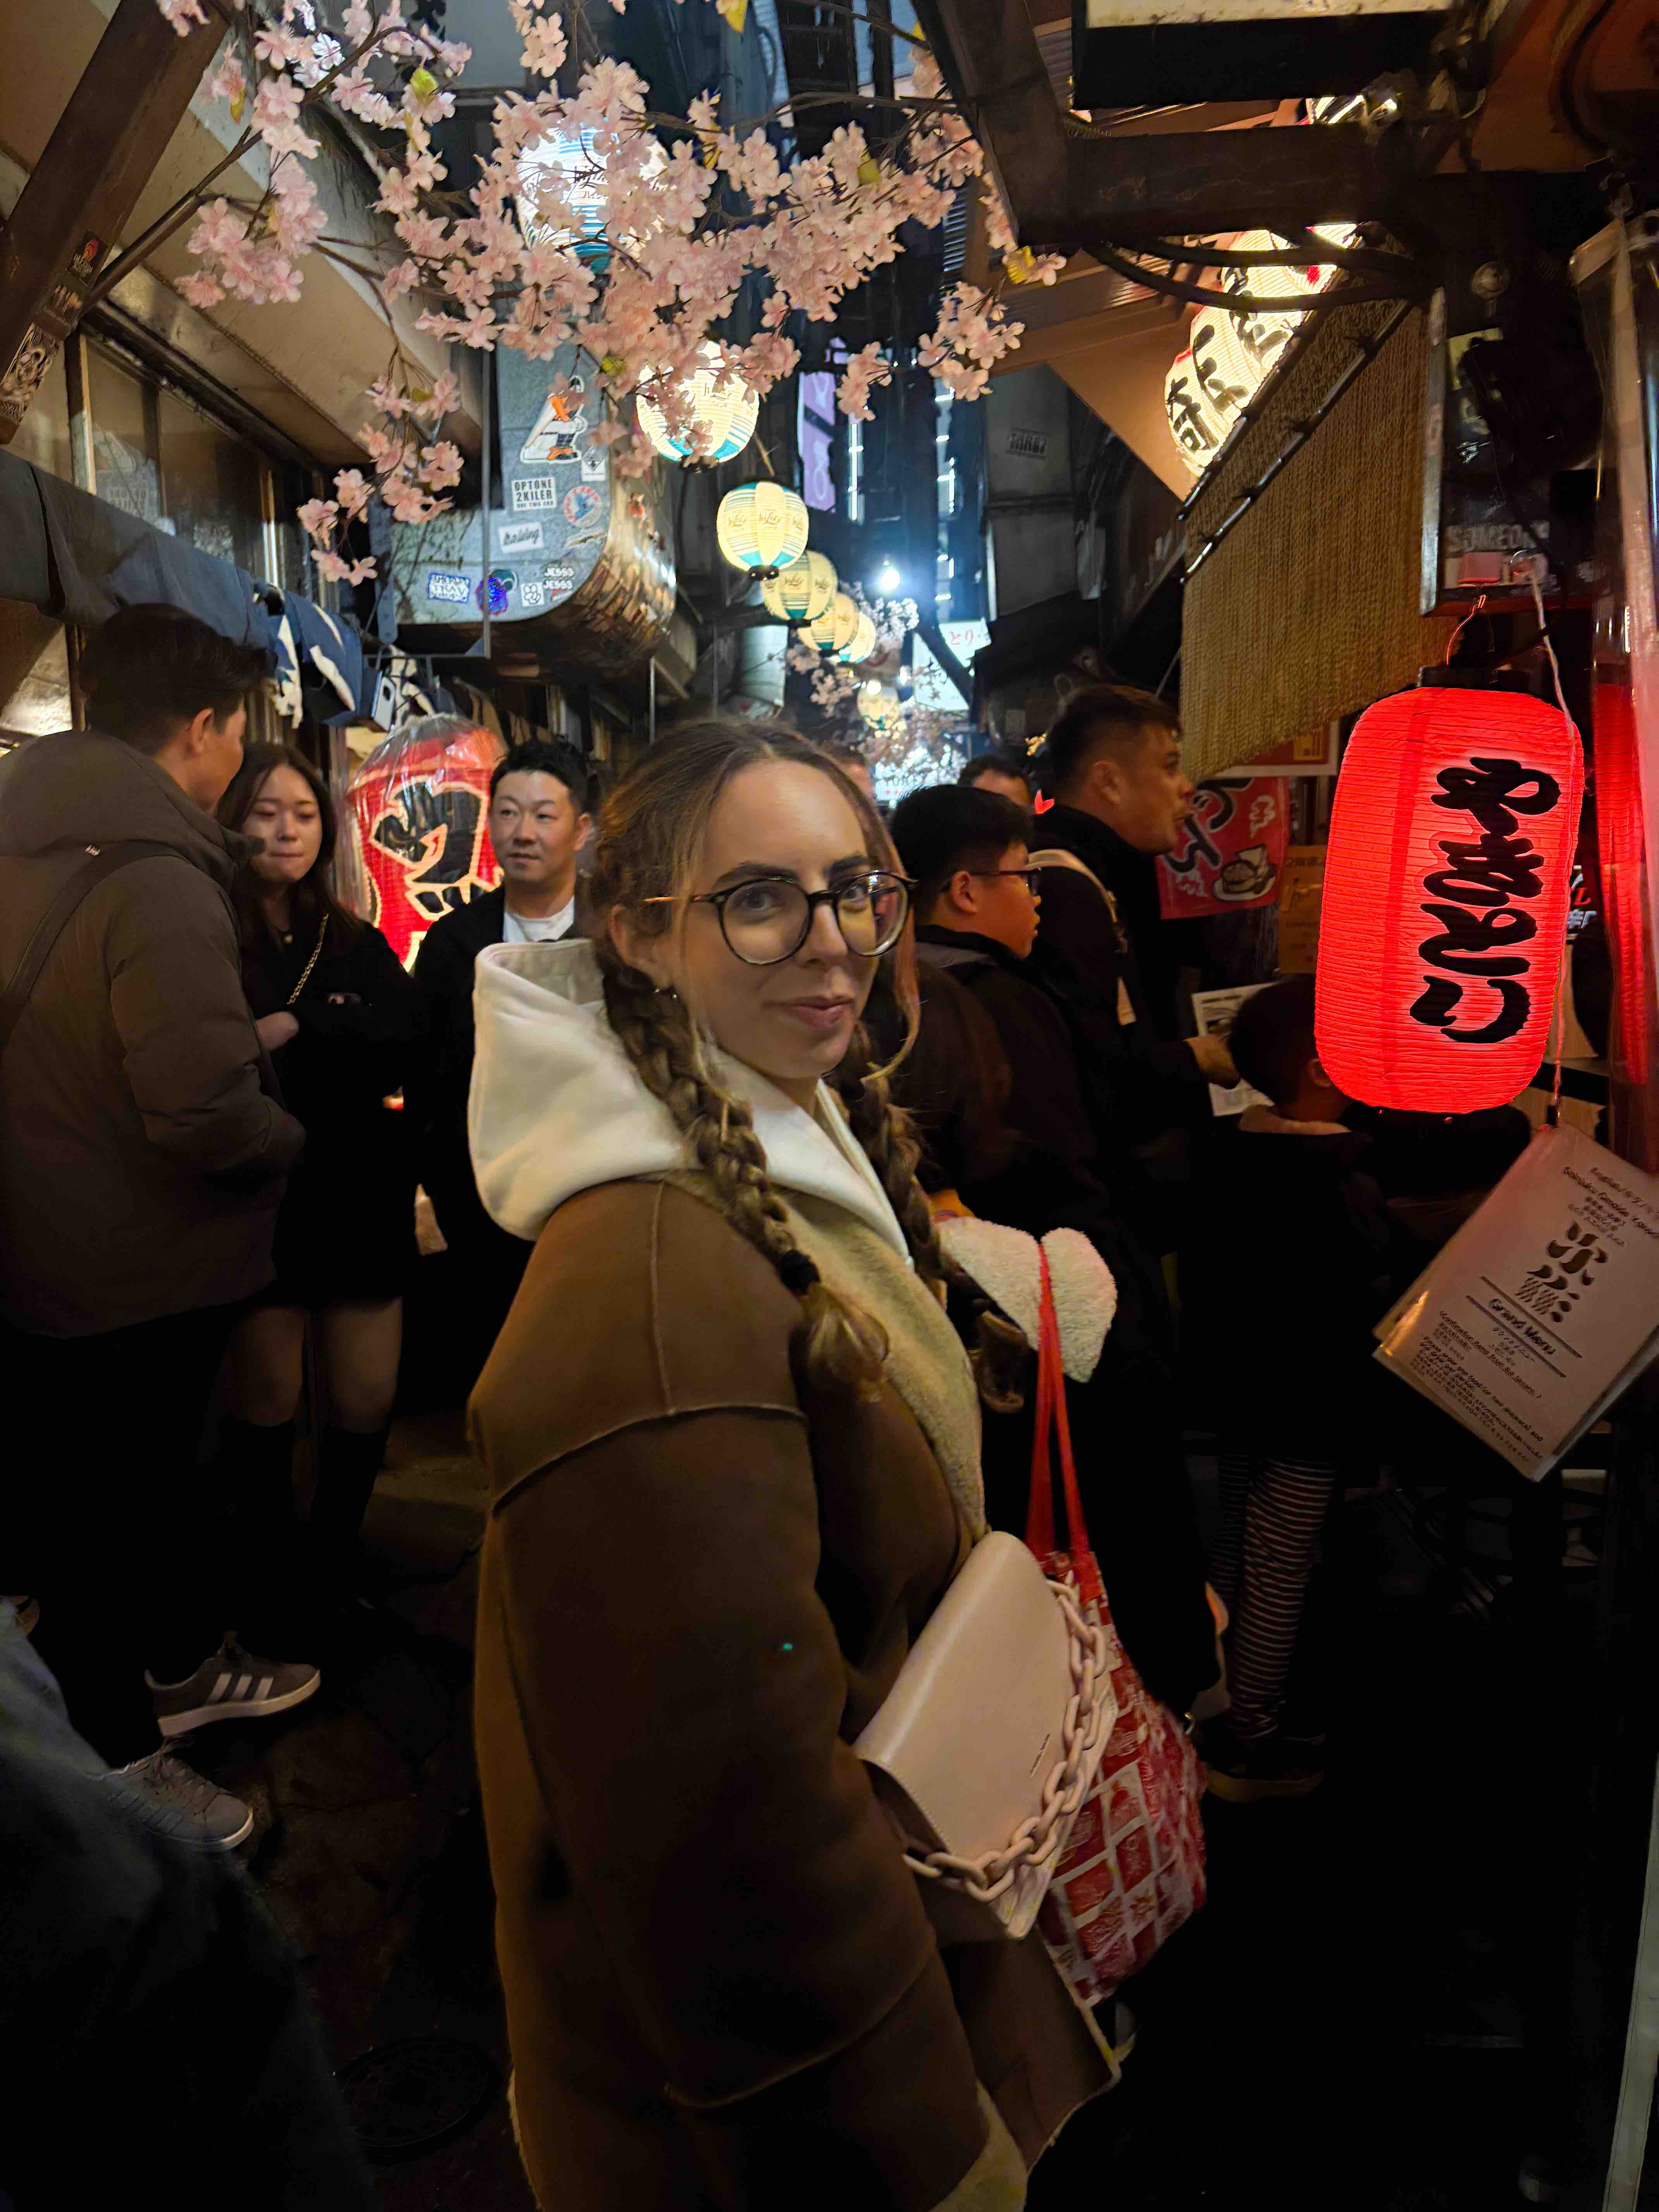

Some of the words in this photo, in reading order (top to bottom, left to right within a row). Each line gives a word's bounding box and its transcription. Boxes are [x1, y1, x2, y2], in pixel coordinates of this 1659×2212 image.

[1409, 756, 1561, 1044] やきとり
[1488, 1297, 1526, 1330] Grand
[1523, 1325, 1556, 1356] Menu
[1530, 1430, 1542, 1442] and
